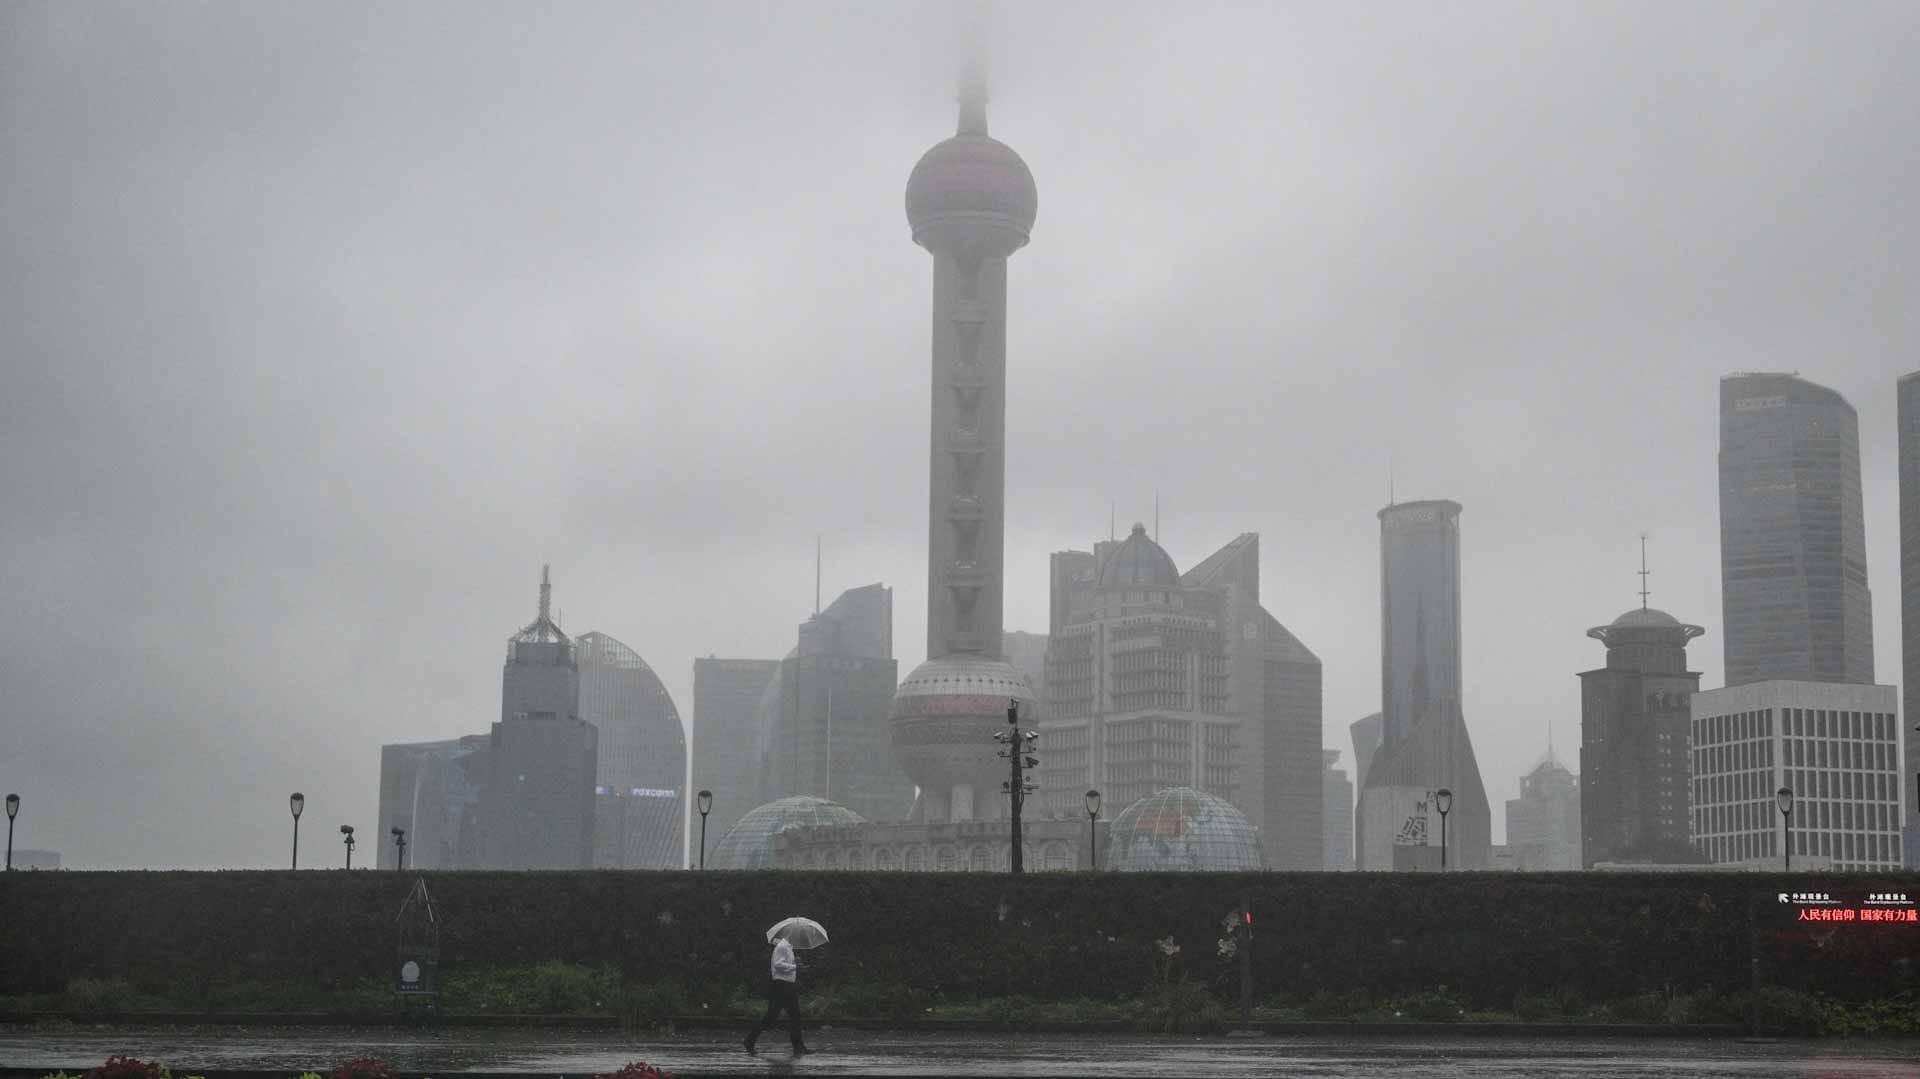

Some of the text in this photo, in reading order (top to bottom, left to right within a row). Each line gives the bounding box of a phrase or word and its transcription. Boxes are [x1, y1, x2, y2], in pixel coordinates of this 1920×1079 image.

[1798, 909, 1918, 921] 人民有信仰 国家有力量
